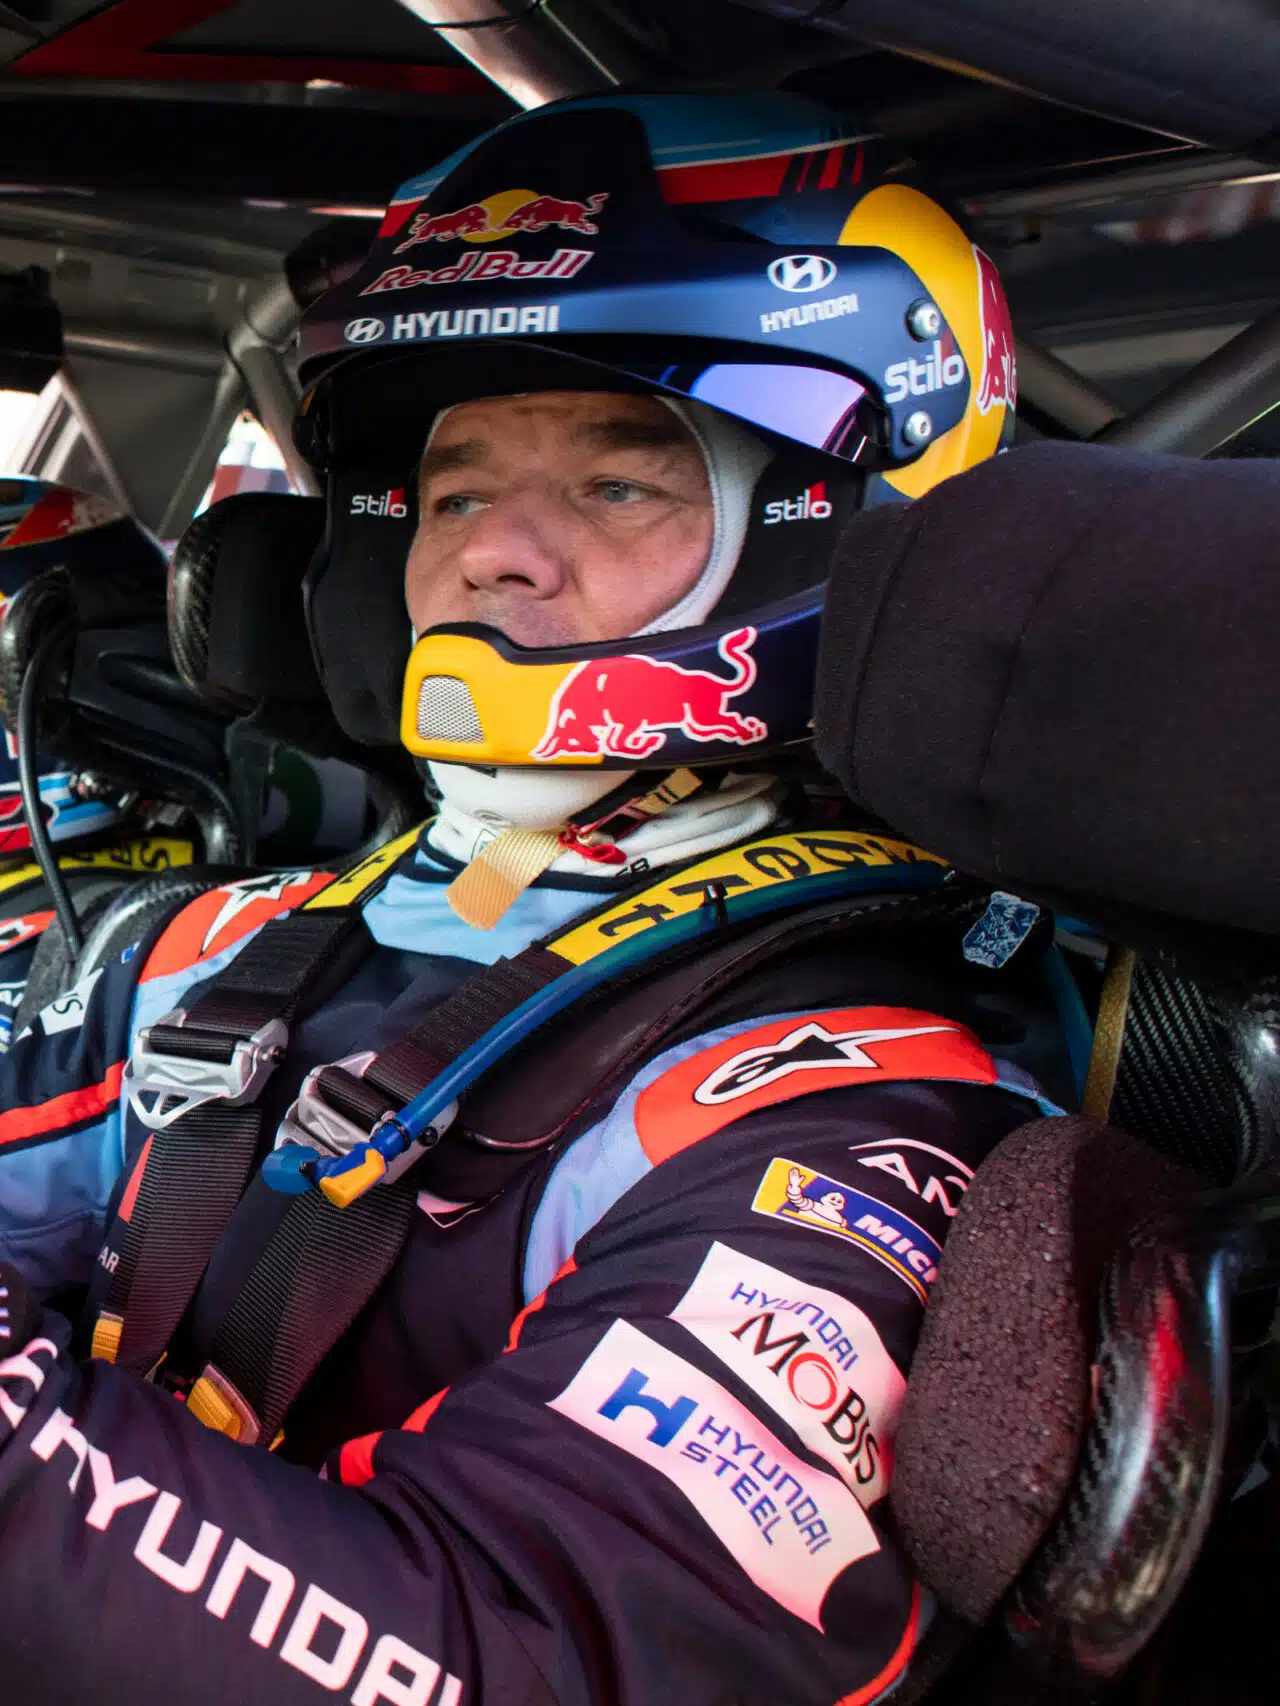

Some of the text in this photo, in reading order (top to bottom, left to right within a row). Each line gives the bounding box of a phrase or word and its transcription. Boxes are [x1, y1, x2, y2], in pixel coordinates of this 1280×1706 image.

[358, 249, 594, 296] Red Bull
[392, 305, 560, 339] HYUNDAI
[760, 293, 859, 333] HYUNDAI
[883, 340, 965, 404] Stilo
[350, 489, 407, 518] Stilo
[762, 487, 832, 525] Stilo
[729, 1281, 859, 1372] HYUNDAI
[728, 1311, 881, 1485] MOBIS
[679, 1440, 783, 1546] STEEL
[697, 1414, 832, 1556] HYUNDAI
